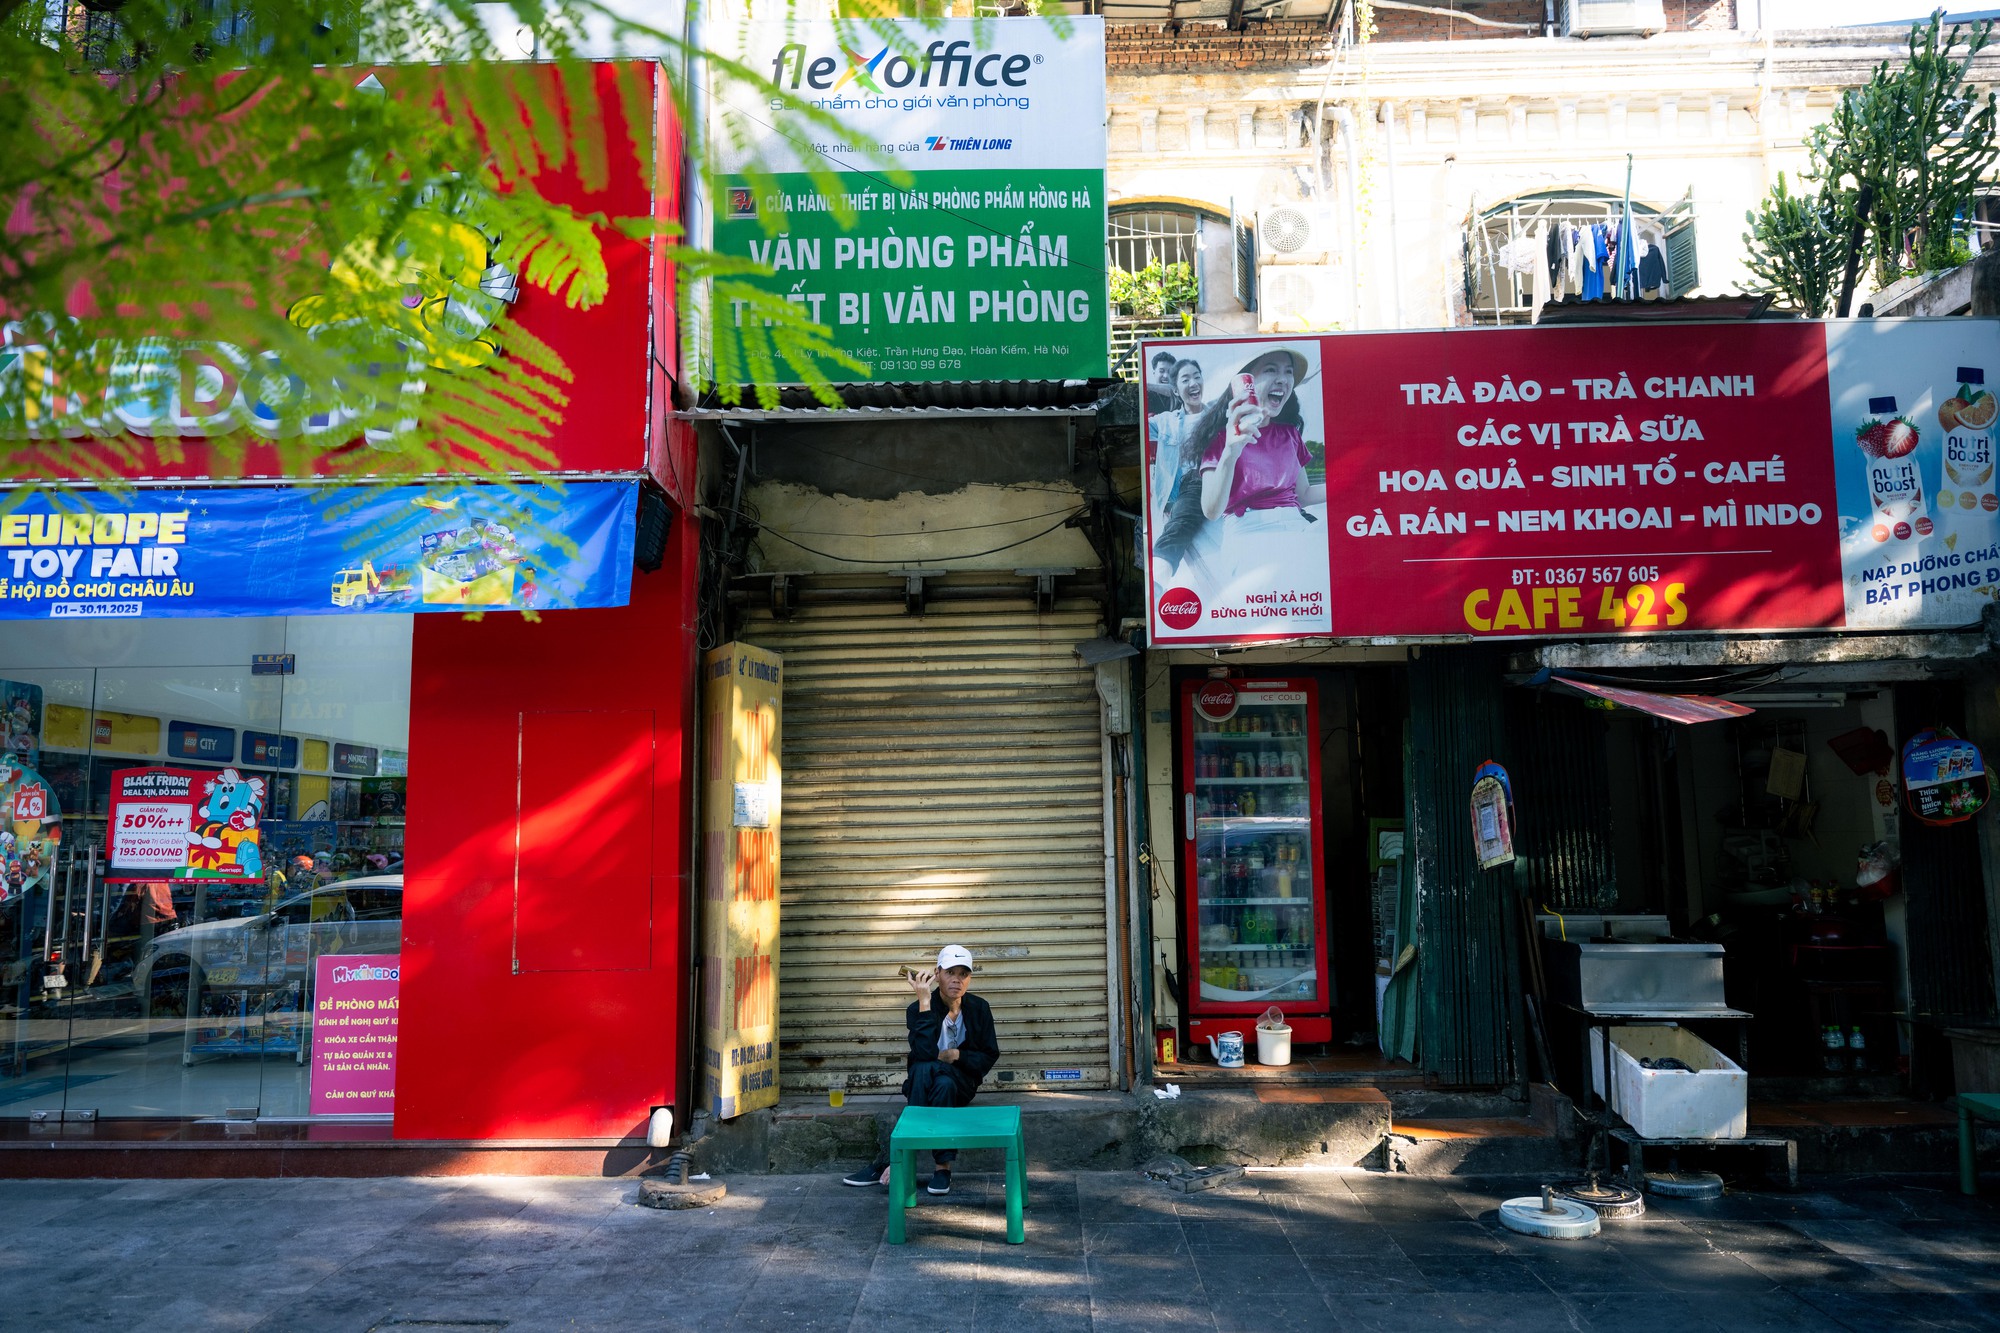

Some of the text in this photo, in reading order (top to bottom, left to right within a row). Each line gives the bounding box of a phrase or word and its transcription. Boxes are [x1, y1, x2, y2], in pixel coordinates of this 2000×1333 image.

[865, 97, 898, 109] cho
[903, 95, 932, 110] giới
[937, 93, 968, 107] văn
[973, 94, 1030, 110] phòng
[898, 141, 920, 151] của
[950, 137, 1012, 150] THIÊN LONG
[766, 183, 1091, 215] CỬA HÀNG THIẾT BỊ VĂN PHÒNG PHẨM HỒNG HÀ
[749, 220, 1068, 271] VĂN PHÒNG PHẨM
[839, 292, 870, 333] BỊ
[883, 284, 955, 324] VĂN
[969, 280, 1090, 323] PHÒNG
[815, 348, 853, 359] Thng
[856, 347, 881, 358] Kiệt,
[885, 346, 908, 356] Trần
[912, 347, 939, 357] Hưng
[942, 345, 967, 357] Đạo,
[970, 345, 997, 355] Hoàn
[1000, 344, 1030, 355] Kiếm,
[1034, 345, 1048, 355] Hà
[1052, 345, 1069, 357] Nội
[880, 361, 917, 370] 09130
[920, 360, 935, 370] 99
[939, 359, 961, 369] 678
[1400, 371, 1755, 406] TRÀ ĐÀO TRÀ CHANH
[1457, 414, 1704, 450] CÁC VỊ TRÀ SỮA
[1948, 436, 1989, 449] nutri
[1948, 447, 1990, 463] boost
[1378, 452, 1786, 493] HOA QUẢ SINH TỐ CAFÉ
[1872, 463, 1913, 480] nutri
[1874, 476, 1917, 493] boost
[1345, 499, 1823, 537] GÀ RÁN NEM KHOAI MÌ INDO
[0, 513, 189, 546] EUROPE
[8, 547, 179, 578] TOY FAIR
[1862, 565, 1897, 583] NẠP
[1901, 554, 1960, 576] DƯỠNG
[1511, 566, 1660, 586] ĐT: 0367 567 605
[11, 581, 42, 601] HỘI
[44, 576, 70, 598] ĐỒ
[73, 581, 115, 597] CHƠI
[119, 579, 167, 597] CHÂU
[169, 578, 195, 596] ÂU
[1866, 582, 1903, 606] BẬT
[1908, 570, 1981, 597] PHONG
[1245, 590, 1322, 604] NGHỈ XẢ HƠI
[55, 604, 138, 614] 01 30.11.2025
[1160, 601, 1199, 615] Coca-Cola
[1211, 603, 1323, 619] BỪNG HỨNG KHỞI
[1463, 586, 1584, 632] CAFE
[1201, 692, 1233, 705] Coca-Cola
[95, 727, 111, 737] LEGO
[200, 738, 218, 751] CITY
[747, 699, 769, 781] VĂN
[123, 775, 192, 788] BLACK FRIDAY
[123, 788, 142, 796] DEAL
[143, 788, 158, 798] XỊN,
[158, 785, 170, 796] ĐỒ
[1919, 788, 1939, 796] THÍCH
[156, 805, 169, 813] ĐẾN
[1921, 800, 1942, 810] NHÍCH
[122, 814, 184, 829] 50%++
[119, 847, 183, 857] 195.000VNĐ
[333, 965, 400, 983] MYKINGDO
[733, 928, 771, 1030] PHẨM
[319, 996, 333, 1010] ĐỀ
[336, 998, 375, 1010] PHÒNG
[319, 1017, 337, 1026] KÍNH
[339, 1016, 349, 1026] ĐỀ
[351, 1018, 371, 1028] NGHỊ
[373, 1016, 390, 1026] QUÝ
[324, 1035, 346, 1044] KHÓA
[359, 1033, 376, 1043] CẨN
[378, 1034, 398, 1045] THẬN
[324, 1052, 333, 1061] TỰ
[334, 1051, 350, 1059] BẢO
[352, 1051, 374, 1059] QUẢN
[323, 1062, 390, 1071] TÀI SẢN CÁ NHÂN.
[326, 1089, 395, 1099] CẢM ƠN QUÝ KHÁ
